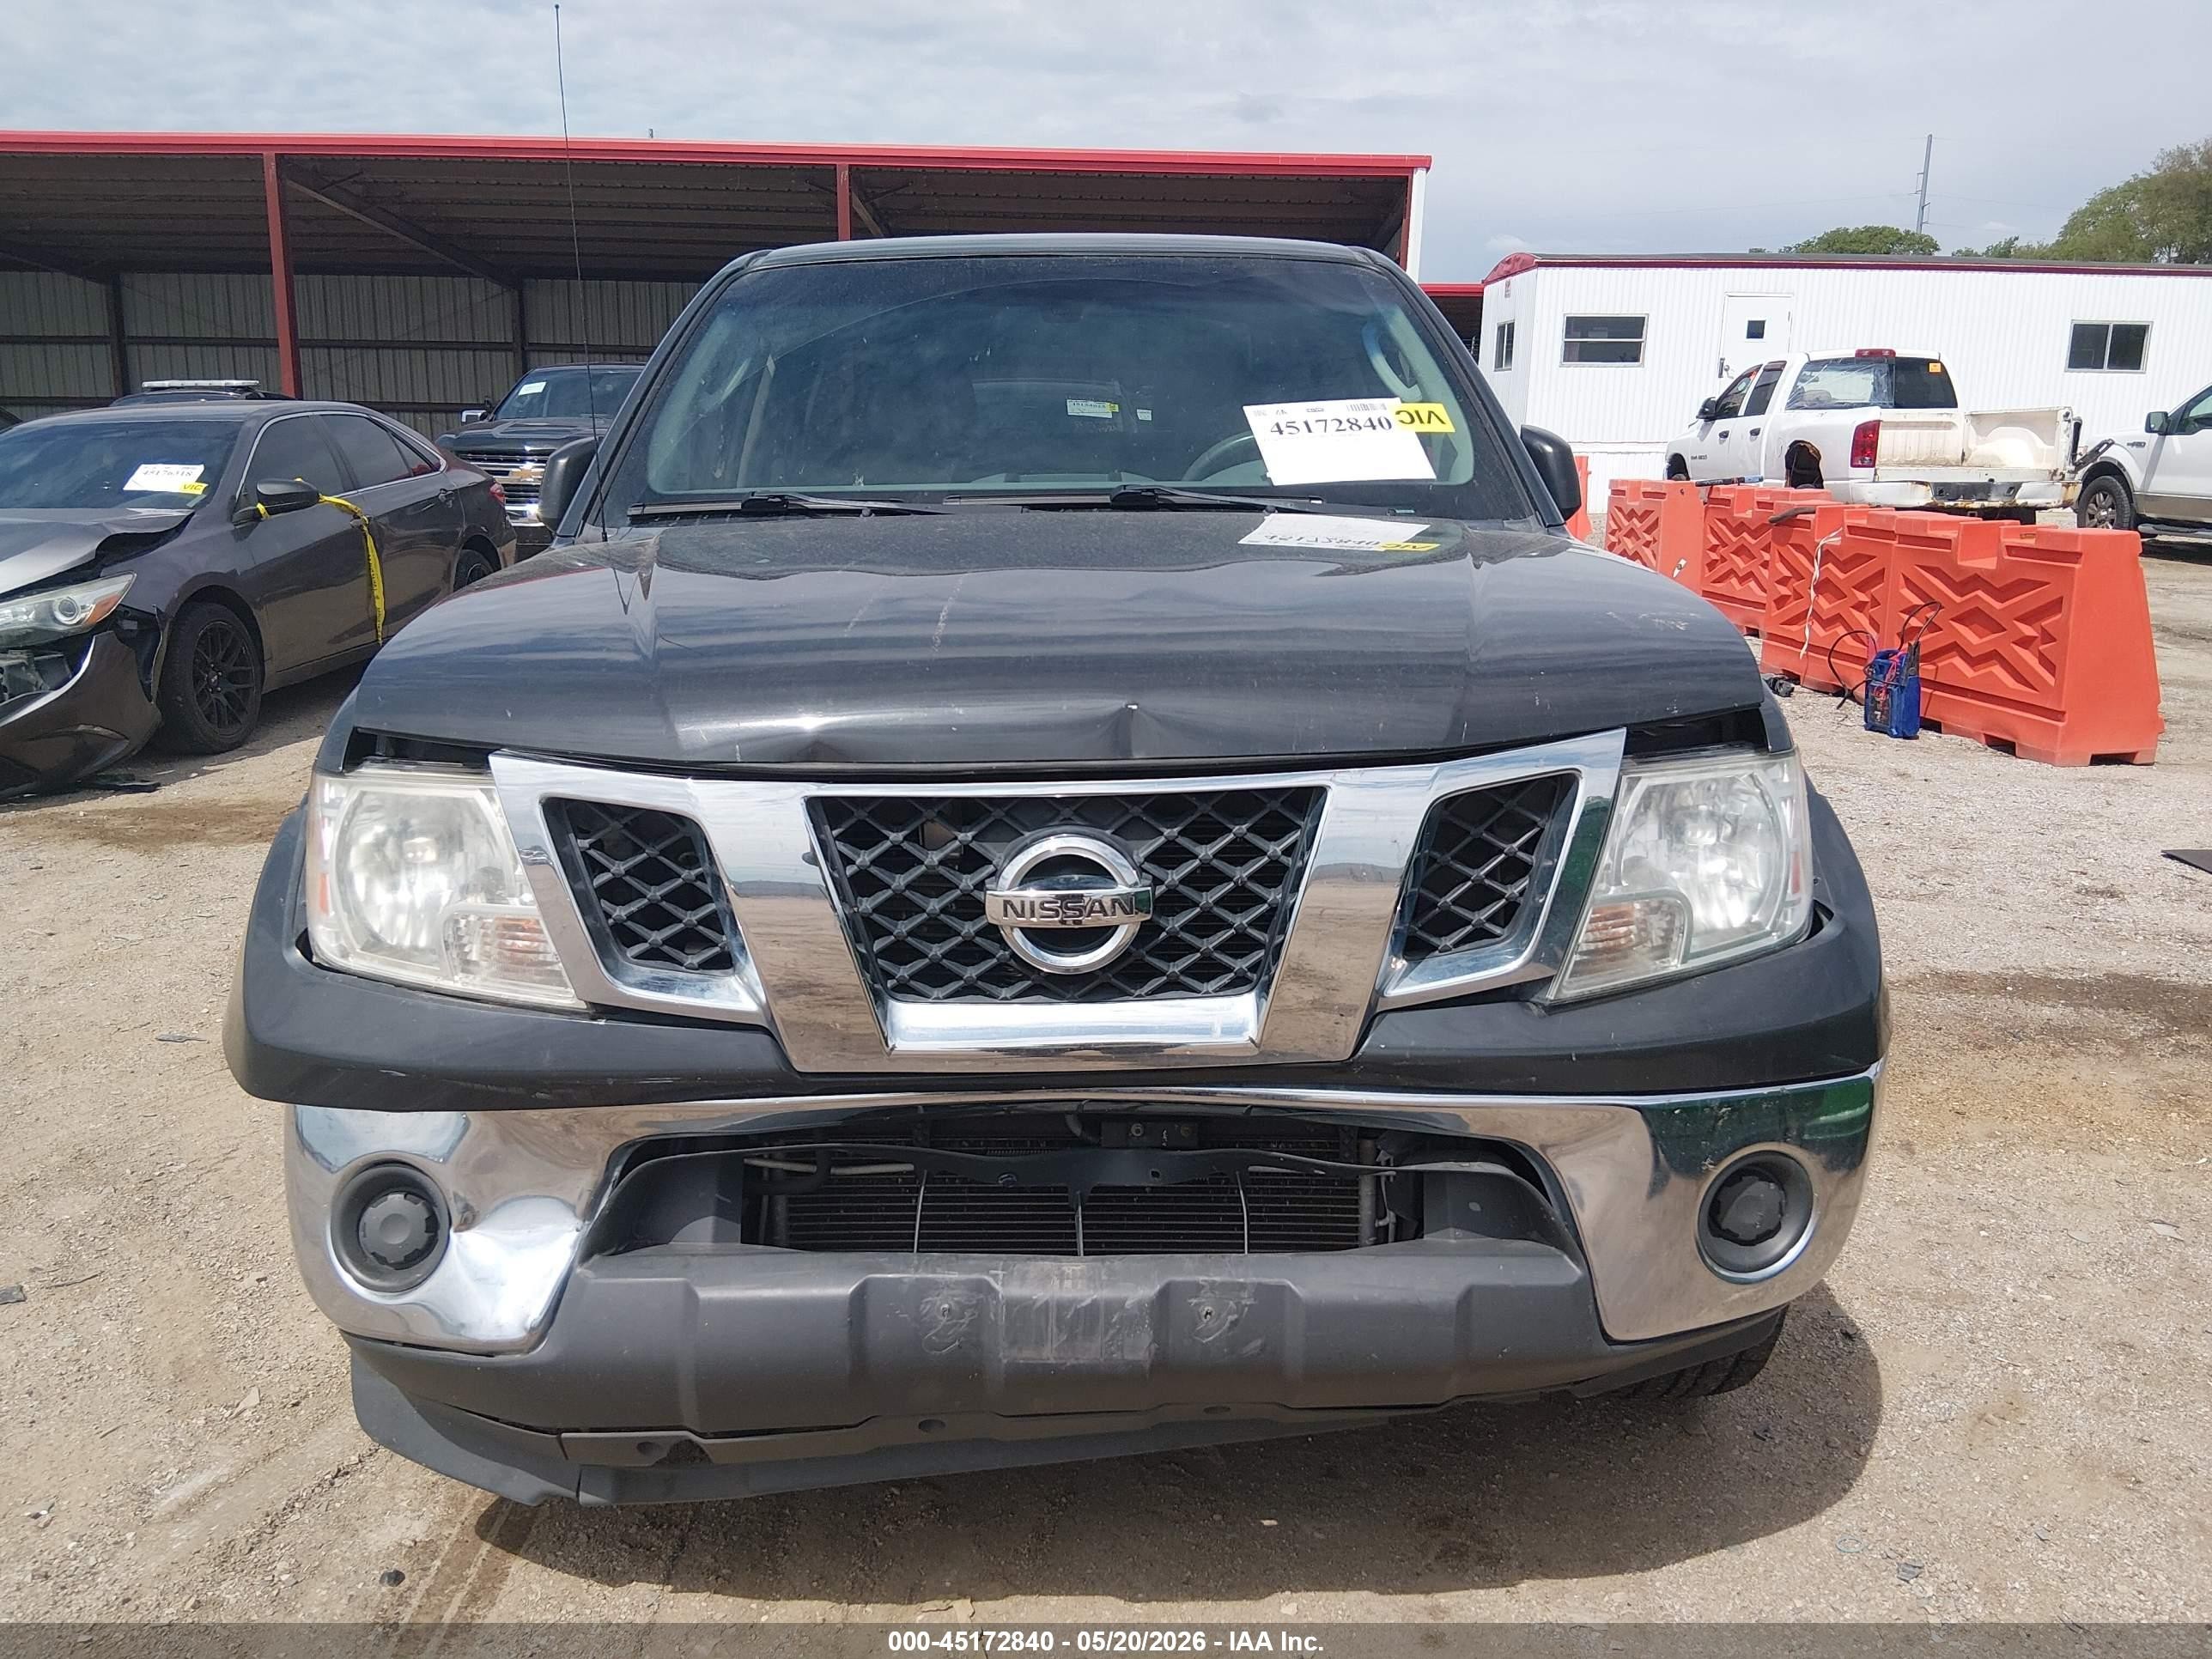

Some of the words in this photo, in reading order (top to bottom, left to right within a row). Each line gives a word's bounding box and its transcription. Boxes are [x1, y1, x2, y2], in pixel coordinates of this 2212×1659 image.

[1271, 416, 1393, 435] 45172840
[1395, 410, 1446, 425] VIC
[1002, 896, 1135, 921] NISSAN
